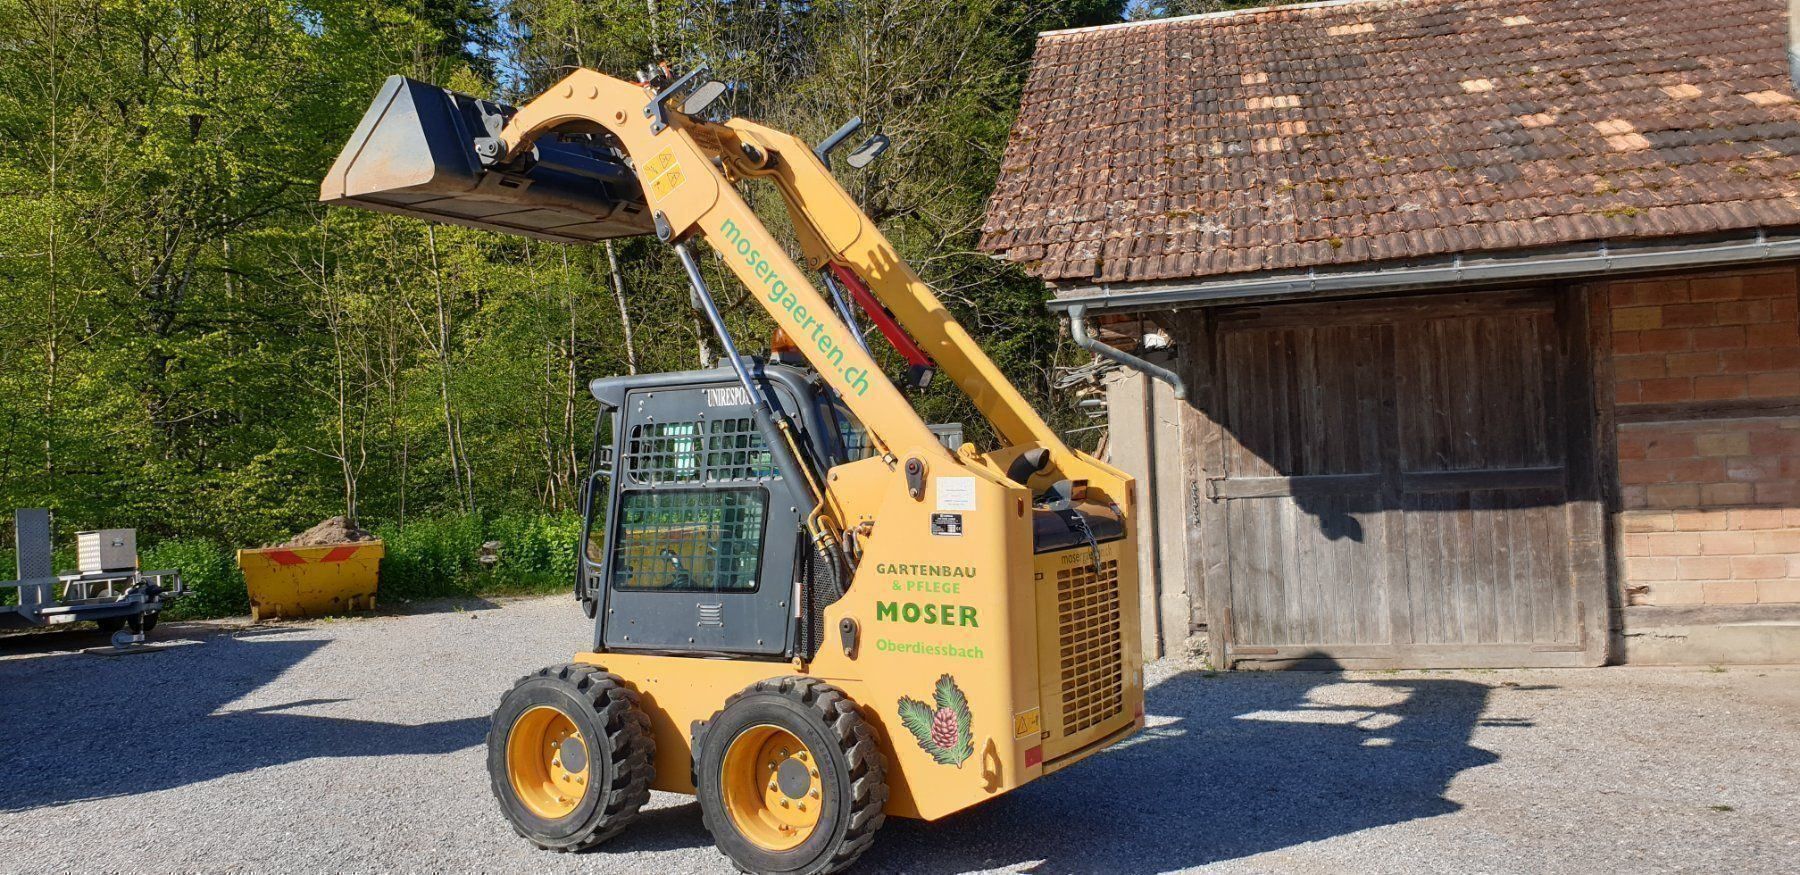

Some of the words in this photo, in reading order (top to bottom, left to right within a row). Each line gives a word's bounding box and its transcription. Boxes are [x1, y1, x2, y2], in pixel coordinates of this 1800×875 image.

[720, 218, 870, 397] mosergaerten.ch
[876, 563, 976, 578] GARTENBAU
[892, 579, 902, 591] &
[906, 580, 961, 594] PFLEGE
[876, 600, 979, 628] MOSER
[876, 638, 985, 659] Oberdiessbach
